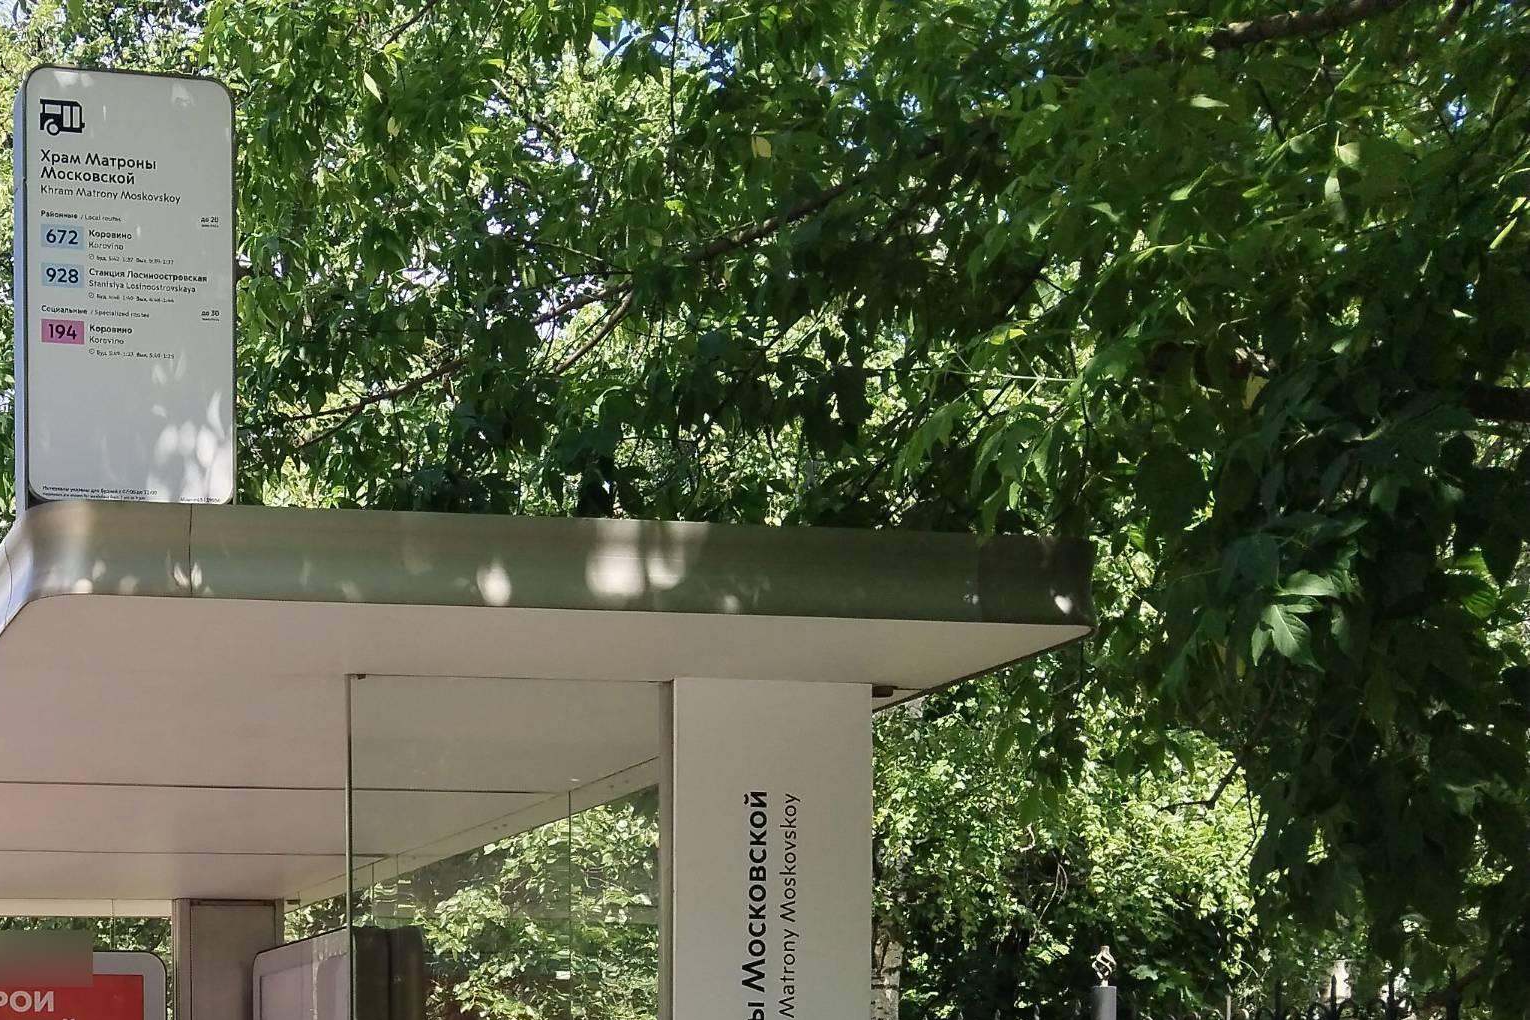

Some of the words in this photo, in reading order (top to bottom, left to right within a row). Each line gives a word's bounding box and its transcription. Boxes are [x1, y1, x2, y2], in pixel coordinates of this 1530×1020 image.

[40, 149, 81, 165] Храм
[85, 153, 156, 170] Матроны
[40, 166, 135, 184] Московской
[40, 185, 73, 196] Khram
[76, 188, 118, 200] Matrony
[120, 191, 181, 204] Moskovskoy
[40, 209, 78, 219] Районные
[46, 229, 79, 245] 672
[88, 229, 133, 240] Коровино
[88, 241, 124, 250] Korovino
[46, 267, 79, 284] 928
[89, 268, 125, 279] Станция
[127, 270, 208, 282] Лосиноостровская
[126, 282, 196, 294] Losinoostrovskaya
[41, 305, 88, 315] Социальные
[48, 323, 77, 340] 194
[89, 324, 133, 334] Коровино
[89, 336, 125, 344] Korovino
[779, 792, 801, 923] Moskovskoy
[742, 790, 768, 993] Московской
[779, 927, 801, 1018] Matrony
